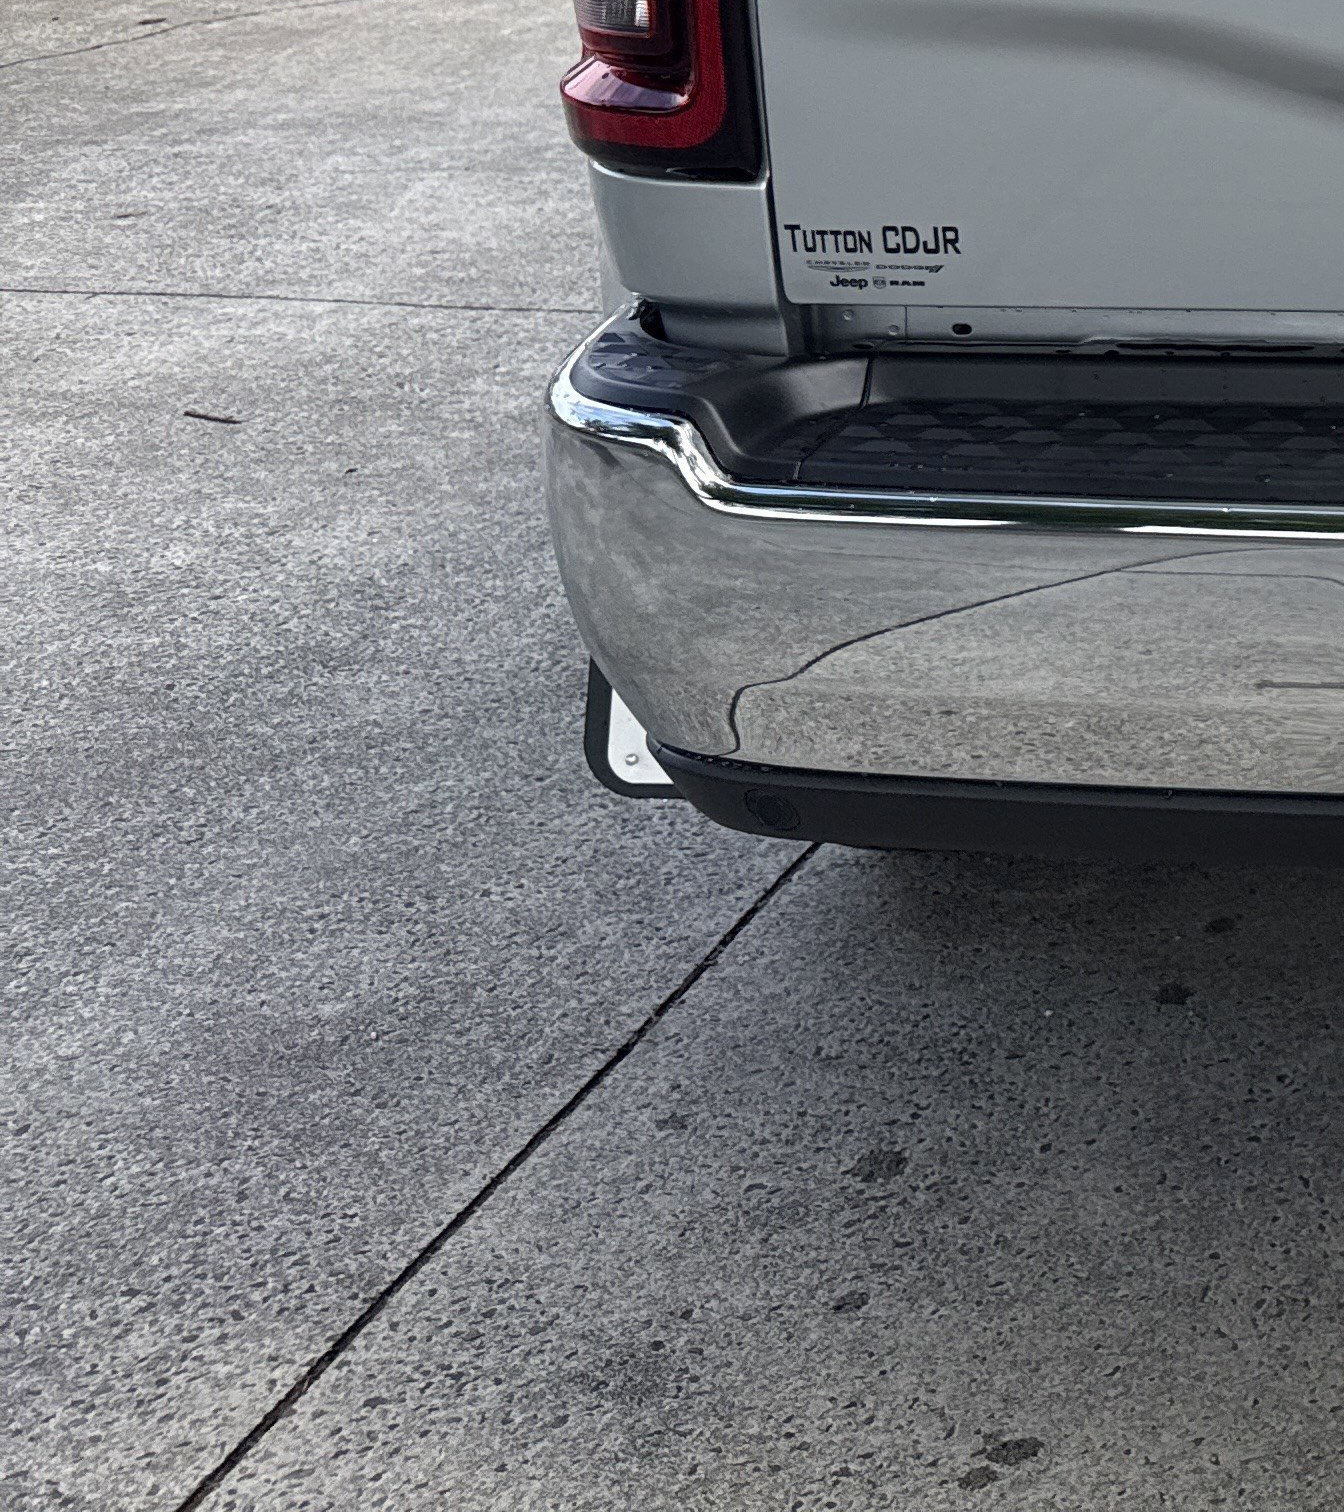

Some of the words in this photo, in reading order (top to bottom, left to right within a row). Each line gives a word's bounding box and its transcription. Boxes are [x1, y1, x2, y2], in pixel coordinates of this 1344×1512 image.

[784, 224, 873, 254] TUTTON
[882, 225, 961, 254] CDJR
[830, 275, 869, 290] Jeep
